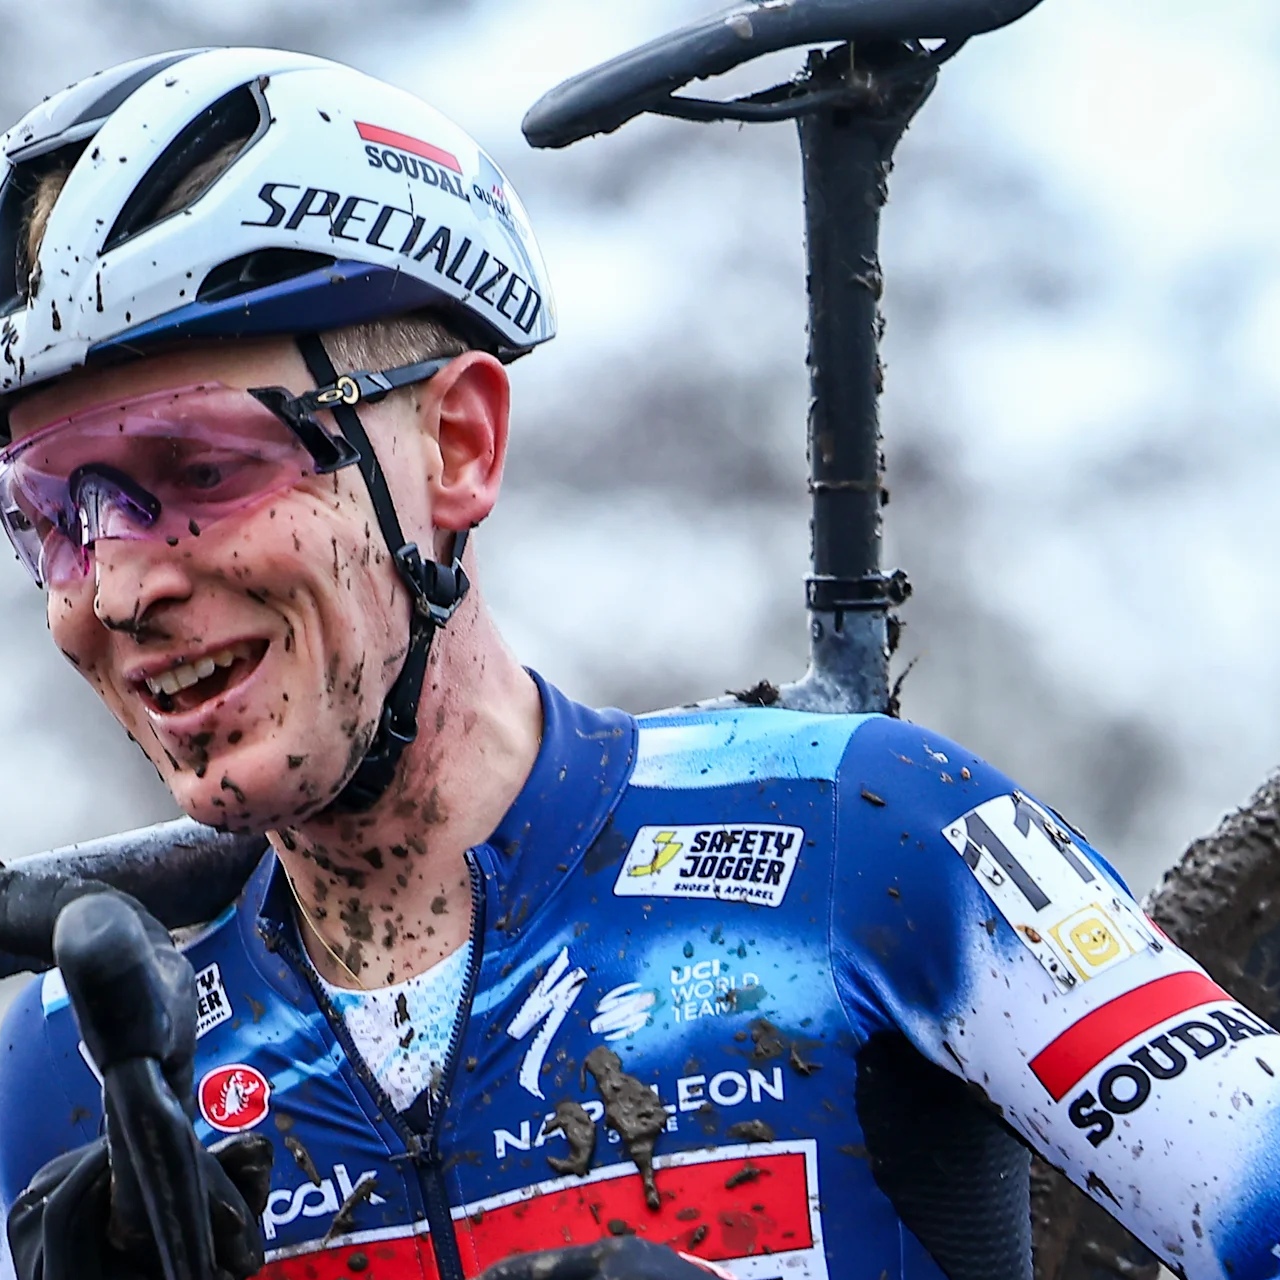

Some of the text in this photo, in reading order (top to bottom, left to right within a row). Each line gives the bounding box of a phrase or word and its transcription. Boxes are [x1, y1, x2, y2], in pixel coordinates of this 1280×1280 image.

[364, 144, 470, 202] SOUDAL
[241, 182, 542, 335] SPECIALIZED
[690, 831, 795, 857] SAFETY
[680, 855, 785, 886] JOGGER
[724, 885, 774, 901] APPAREL
[671, 959, 720, 985] UCI
[671, 972, 760, 1004] WORLD
[1067, 1008, 1280, 1148] SOUDAL
